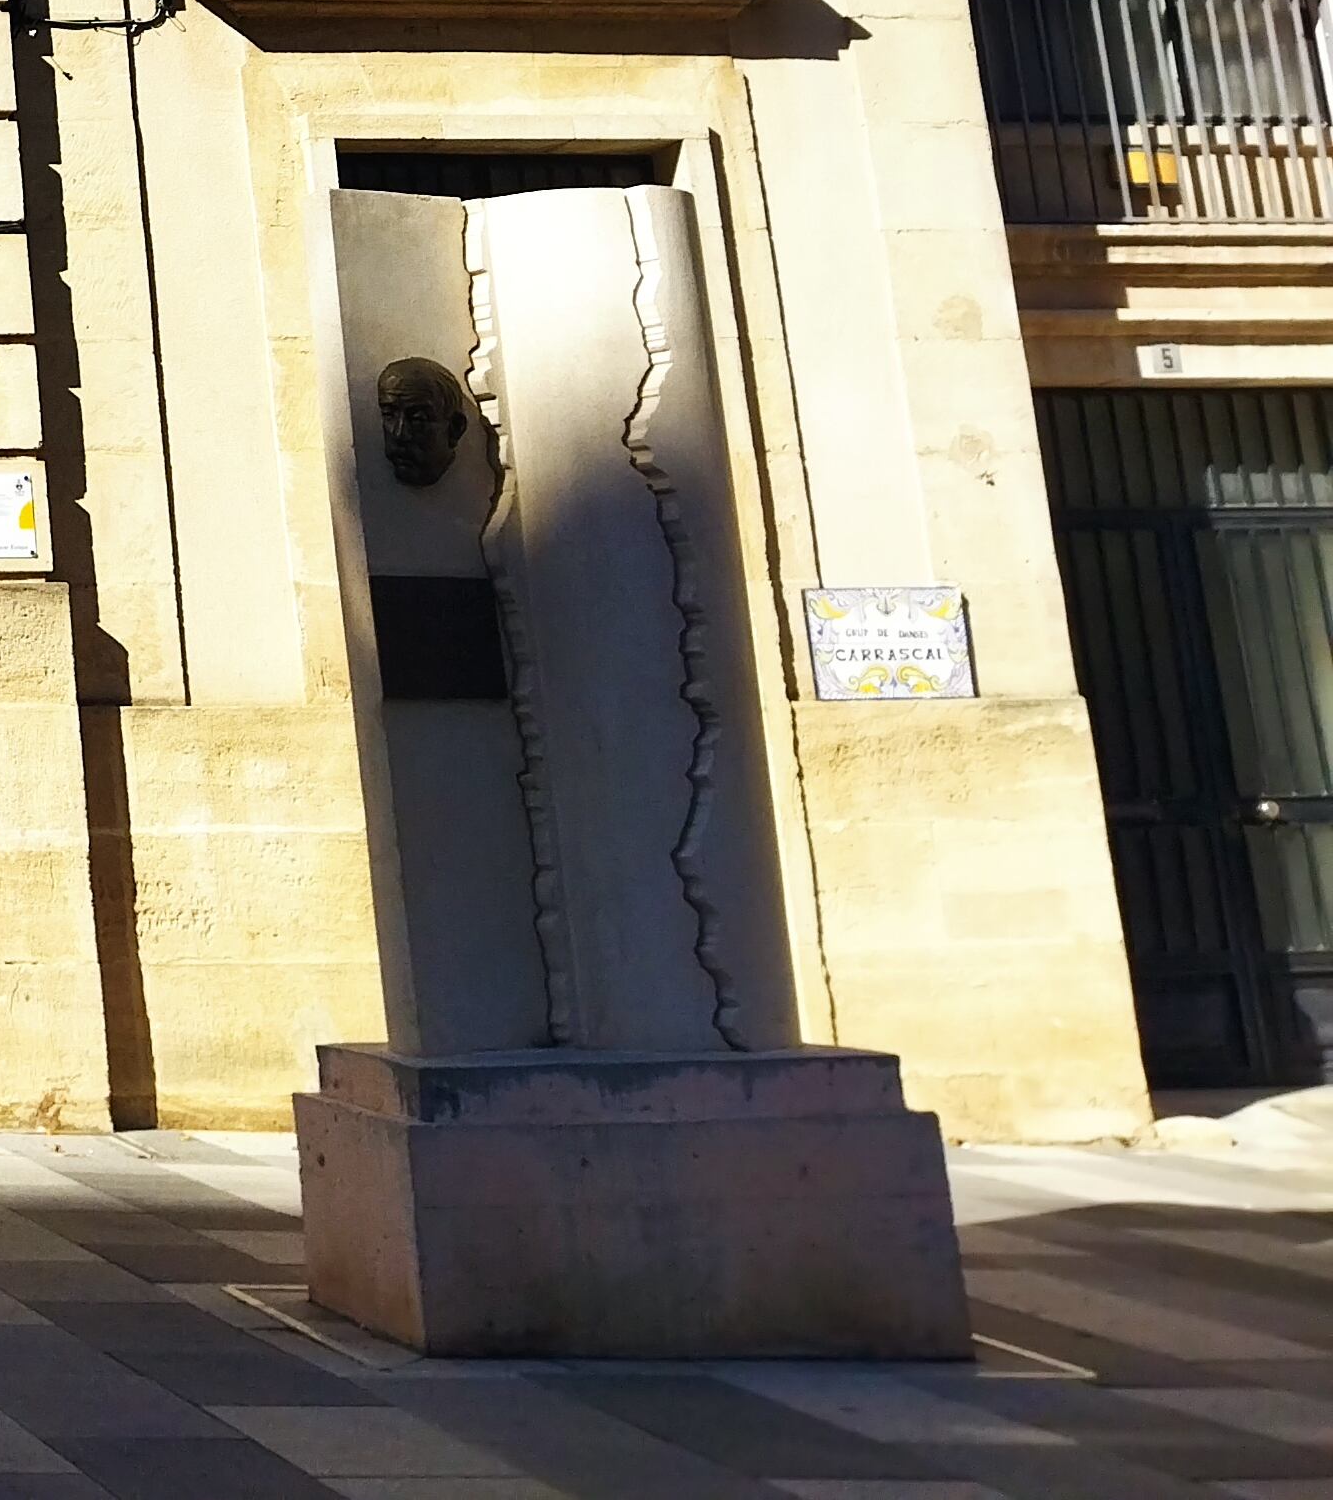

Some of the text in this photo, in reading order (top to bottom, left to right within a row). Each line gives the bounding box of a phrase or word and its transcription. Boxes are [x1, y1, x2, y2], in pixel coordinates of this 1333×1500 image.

[1161, 348, 1174, 369] 5
[877, 628, 889, 638] DE
[835, 648, 944, 661] CARRASCAL
